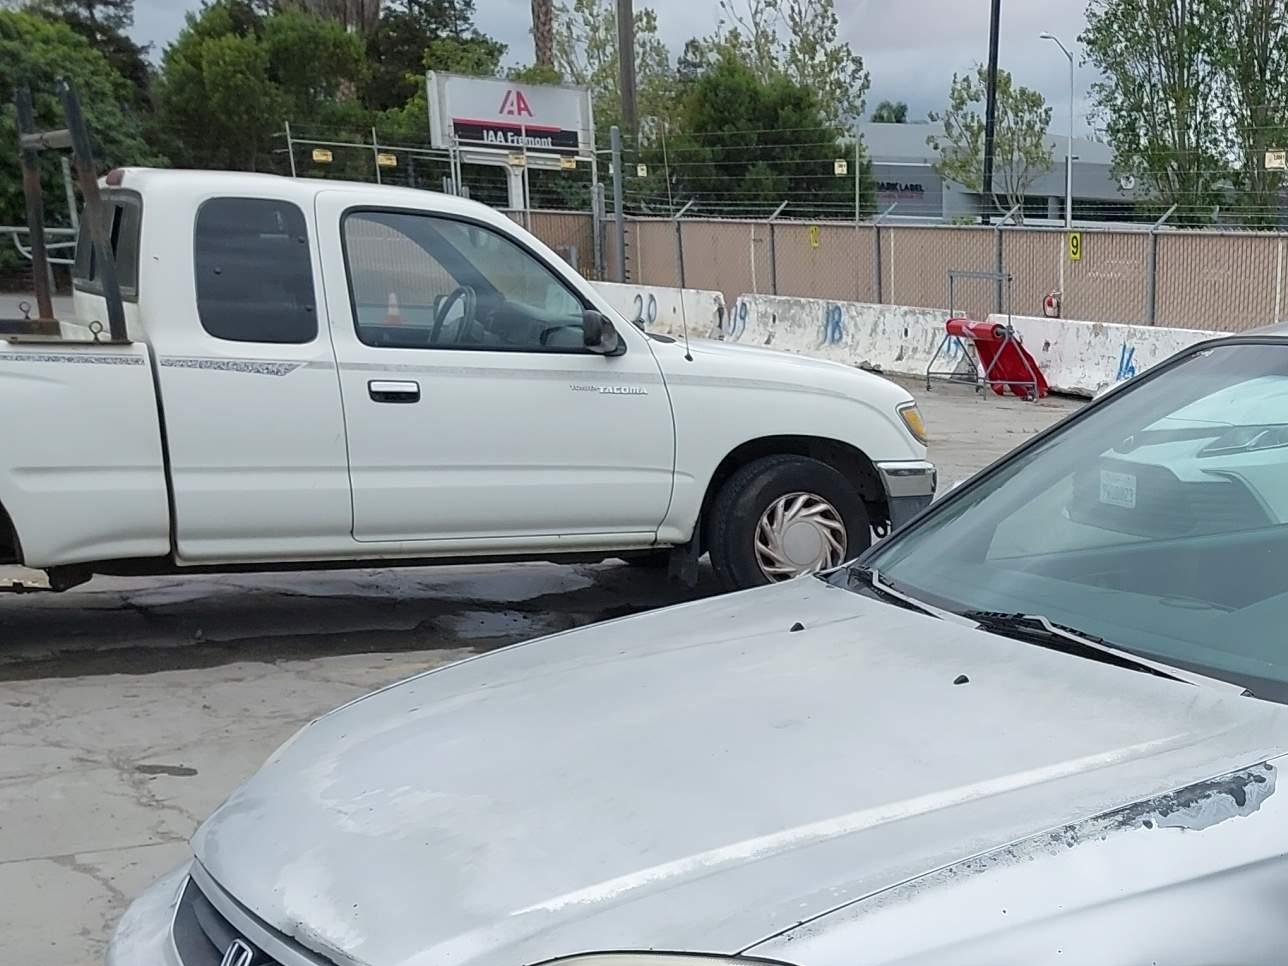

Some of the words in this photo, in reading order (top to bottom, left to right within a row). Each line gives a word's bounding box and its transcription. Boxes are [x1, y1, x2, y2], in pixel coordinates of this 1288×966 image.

[483, 129, 506, 145] IAA
[507, 131, 553, 148] Fremont
[1071, 235, 1080, 256] 9
[599, 386, 648, 395] TACOMA
